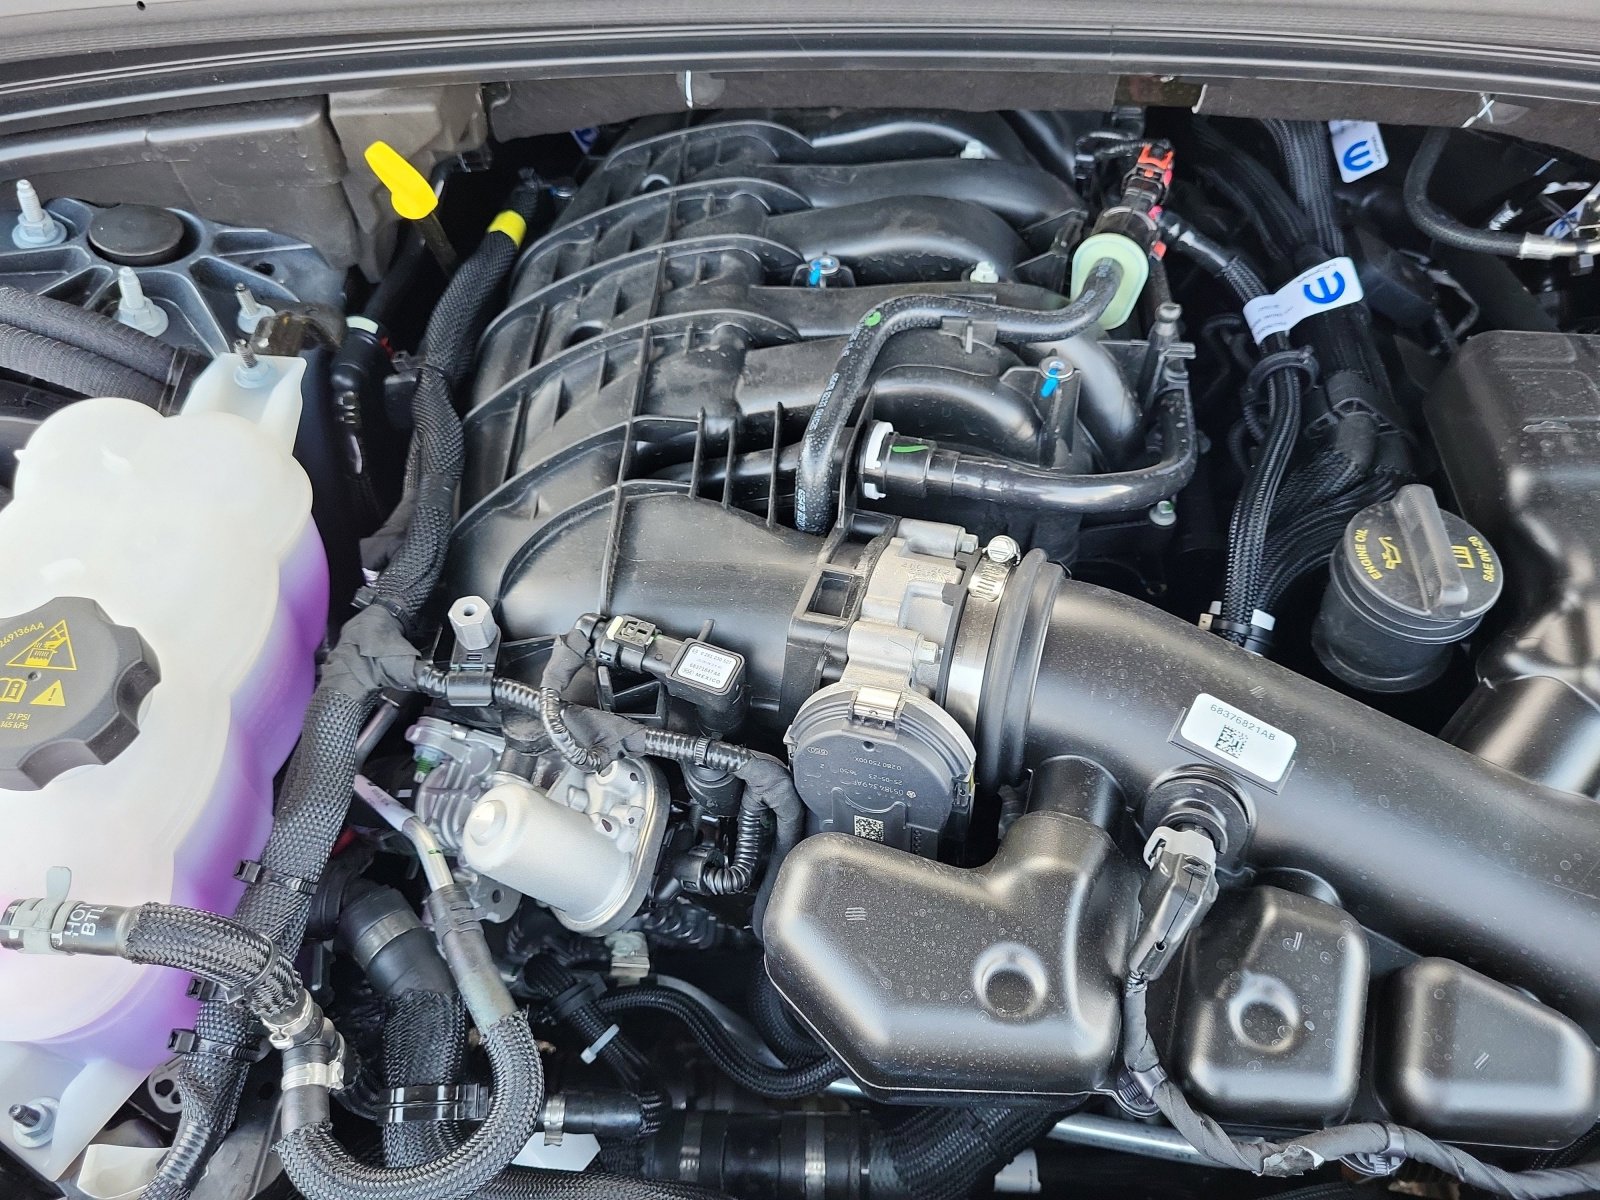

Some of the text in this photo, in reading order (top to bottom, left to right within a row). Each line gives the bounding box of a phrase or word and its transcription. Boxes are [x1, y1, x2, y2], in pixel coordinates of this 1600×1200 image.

[1354, 529, 1383, 580] ENGINE OIL
[1467, 535, 1495, 582] SAE 0W-20
[695, 672, 721, 684] MEXICO
[7, 712, 31, 721] 21 PSI
[1210, 704, 1276, 741] 68376821AB
[81, 906, 108, 936] BTL
